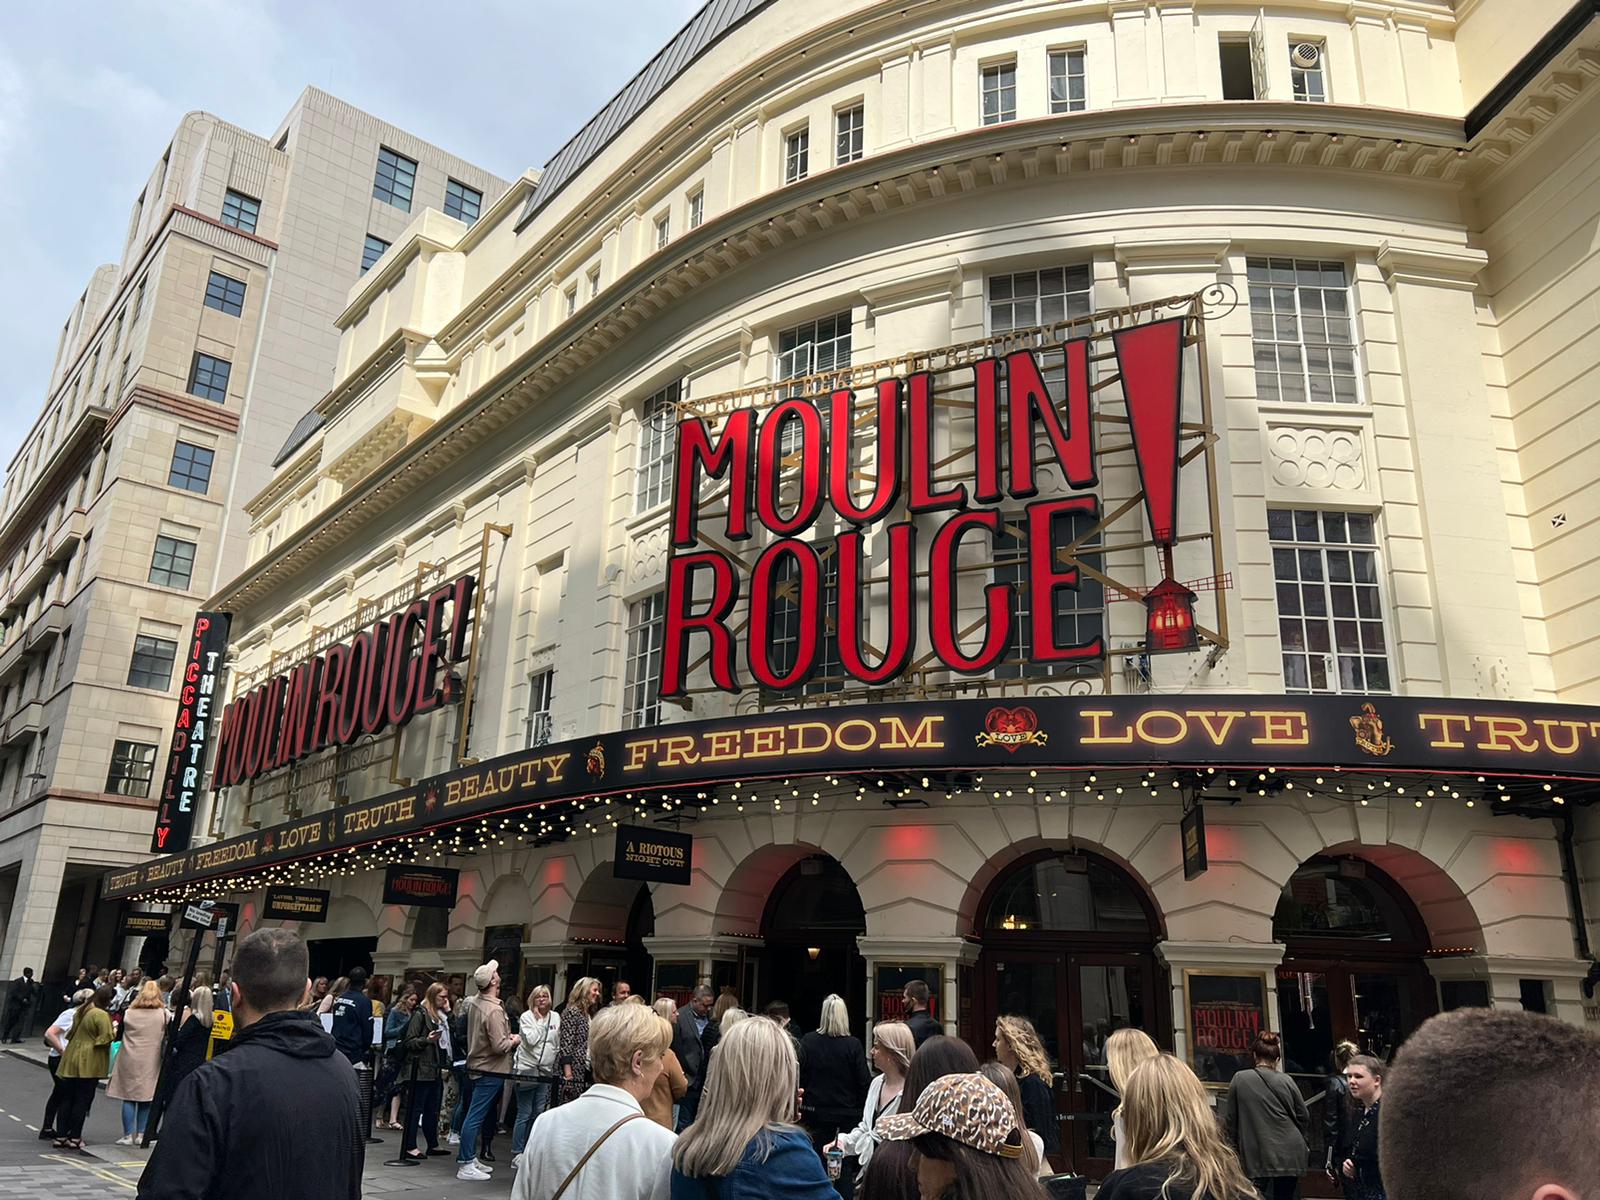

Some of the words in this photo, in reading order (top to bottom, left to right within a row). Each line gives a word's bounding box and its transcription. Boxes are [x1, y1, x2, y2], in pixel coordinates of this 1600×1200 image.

[671, 336, 1098, 548] MOULIN
[657, 493, 1106, 697] ROUGE
[157, 618, 210, 848] PICCADILLY
[179, 651, 219, 812] THEATRE
[211, 656, 325, 791] MOULIN
[311, 575, 475, 751] ROUGE!
[110, 871, 138, 890] TRUTH
[146, 858, 186, 882] BEAUTY
[195, 839, 258, 870] FREEDOM
[278, 822, 321, 850] LOVE
[343, 796, 417, 834] TRUTH
[443, 752, 571, 808] BEAUTY
[623, 715, 945, 771] FREEDOM
[1079, 710, 1310, 746] LOVE
[625, 853, 662, 865] NIGHT
[639, 842, 684, 859] RIOTOUS
[1195, 1008, 1250, 1029] MOULIN
[1196, 1027, 1251, 1049] ROUGE
